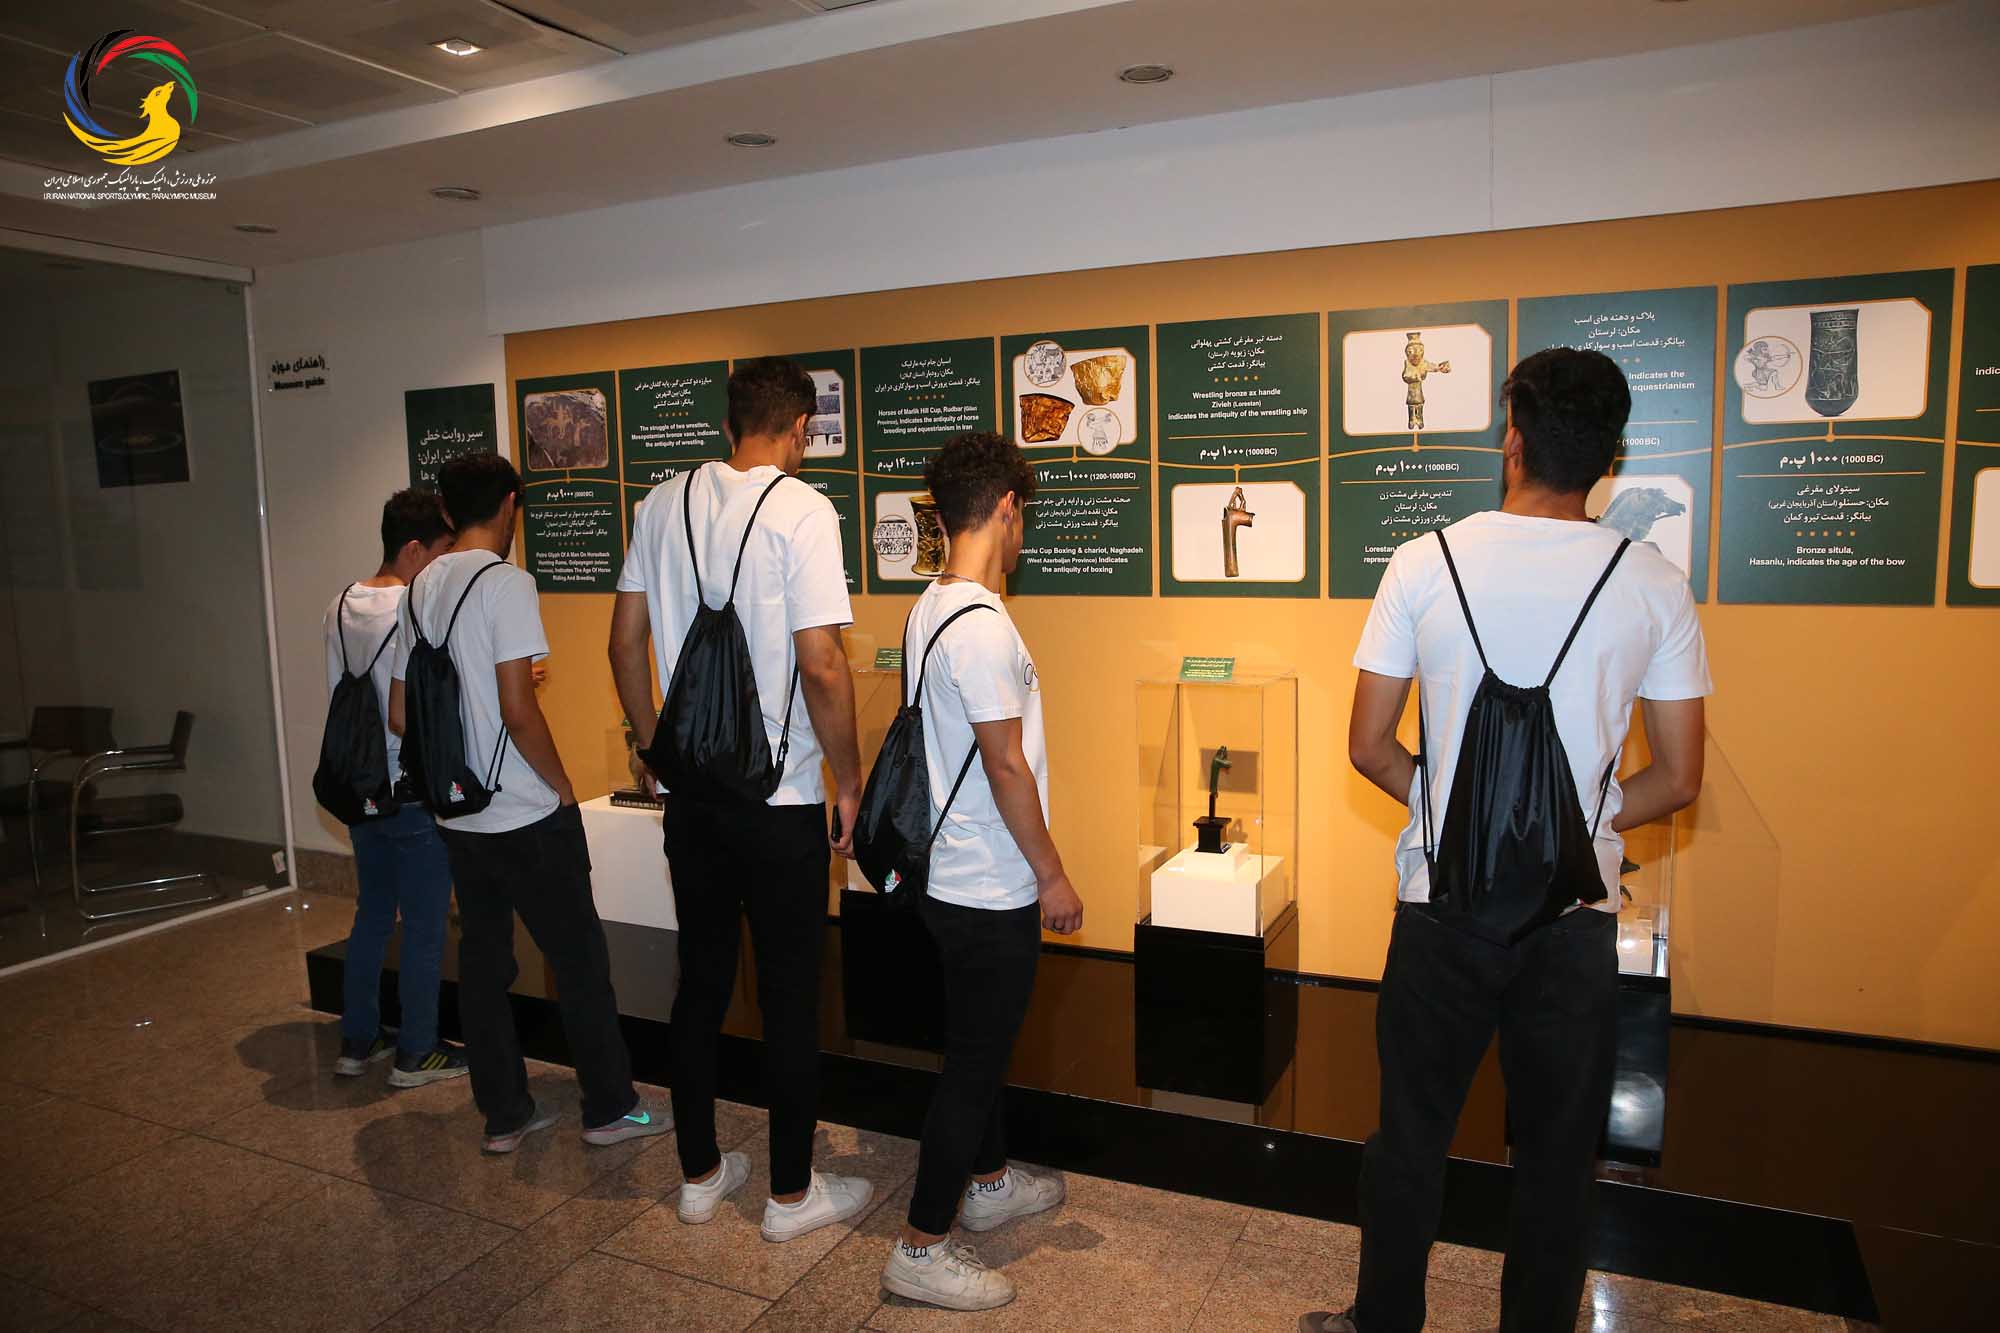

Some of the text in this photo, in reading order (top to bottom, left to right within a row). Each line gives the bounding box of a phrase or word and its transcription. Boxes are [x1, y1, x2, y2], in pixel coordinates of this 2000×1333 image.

[1574, 311, 1656, 326] پلاک دهنه های اسب
[1588, 326, 1641, 339] مکان: لرستان
[1214, 337, 1232, 347] کشتی
[1617, 340, 1635, 348] اسب
[1636, 338, 1659, 346] قدمت
[1660, 337, 1685, 348] بیانگر:
[272, 356, 325, 375] راهنمای موزه
[1208, 362, 1226, 372] کشتی
[1227, 361, 1245, 369] قدمت
[1670, 370, 1685, 378] the
[1632, 382, 1695, 392] equestrianism
[1192, 391, 1223, 399] Wrestling
[1210, 410, 1238, 419] antiquity
[1260, 408, 1292, 417] wrestling
[1292, 407, 1308, 415] ship
[918, 425, 955, 433] equestrianism
[420, 428, 483, 446] سیر روایت خطی
[1380, 489, 1452, 500] تندیس مفرغی مشت زن
[1797, 484, 1860, 496] سیتولای مفرغی
[1394, 502, 1437, 512] مکان: لرستان
[1838, 499, 1865, 509] حسنلو
[1866, 498, 1889, 508] مکان:
[1381, 516, 1392, 525] زنی
[1411, 516, 1430, 525] ورزش
[1431, 515, 1451, 524] بیانگر:
[1783, 513, 1802, 523] کمان
[1847, 512, 1872, 523] بیانگر:
[1828, 546, 1854, 554] situla,
[1749, 559, 1785, 567] Hasanlu,
[1787, 558, 1825, 566] indicates
[1826, 558, 1840, 566] the
[1842, 559, 1858, 567] age
[1870, 558, 1885, 566] the
[978, 1177, 1005, 1192] POLO
[902, 1243, 927, 1258] POLO
